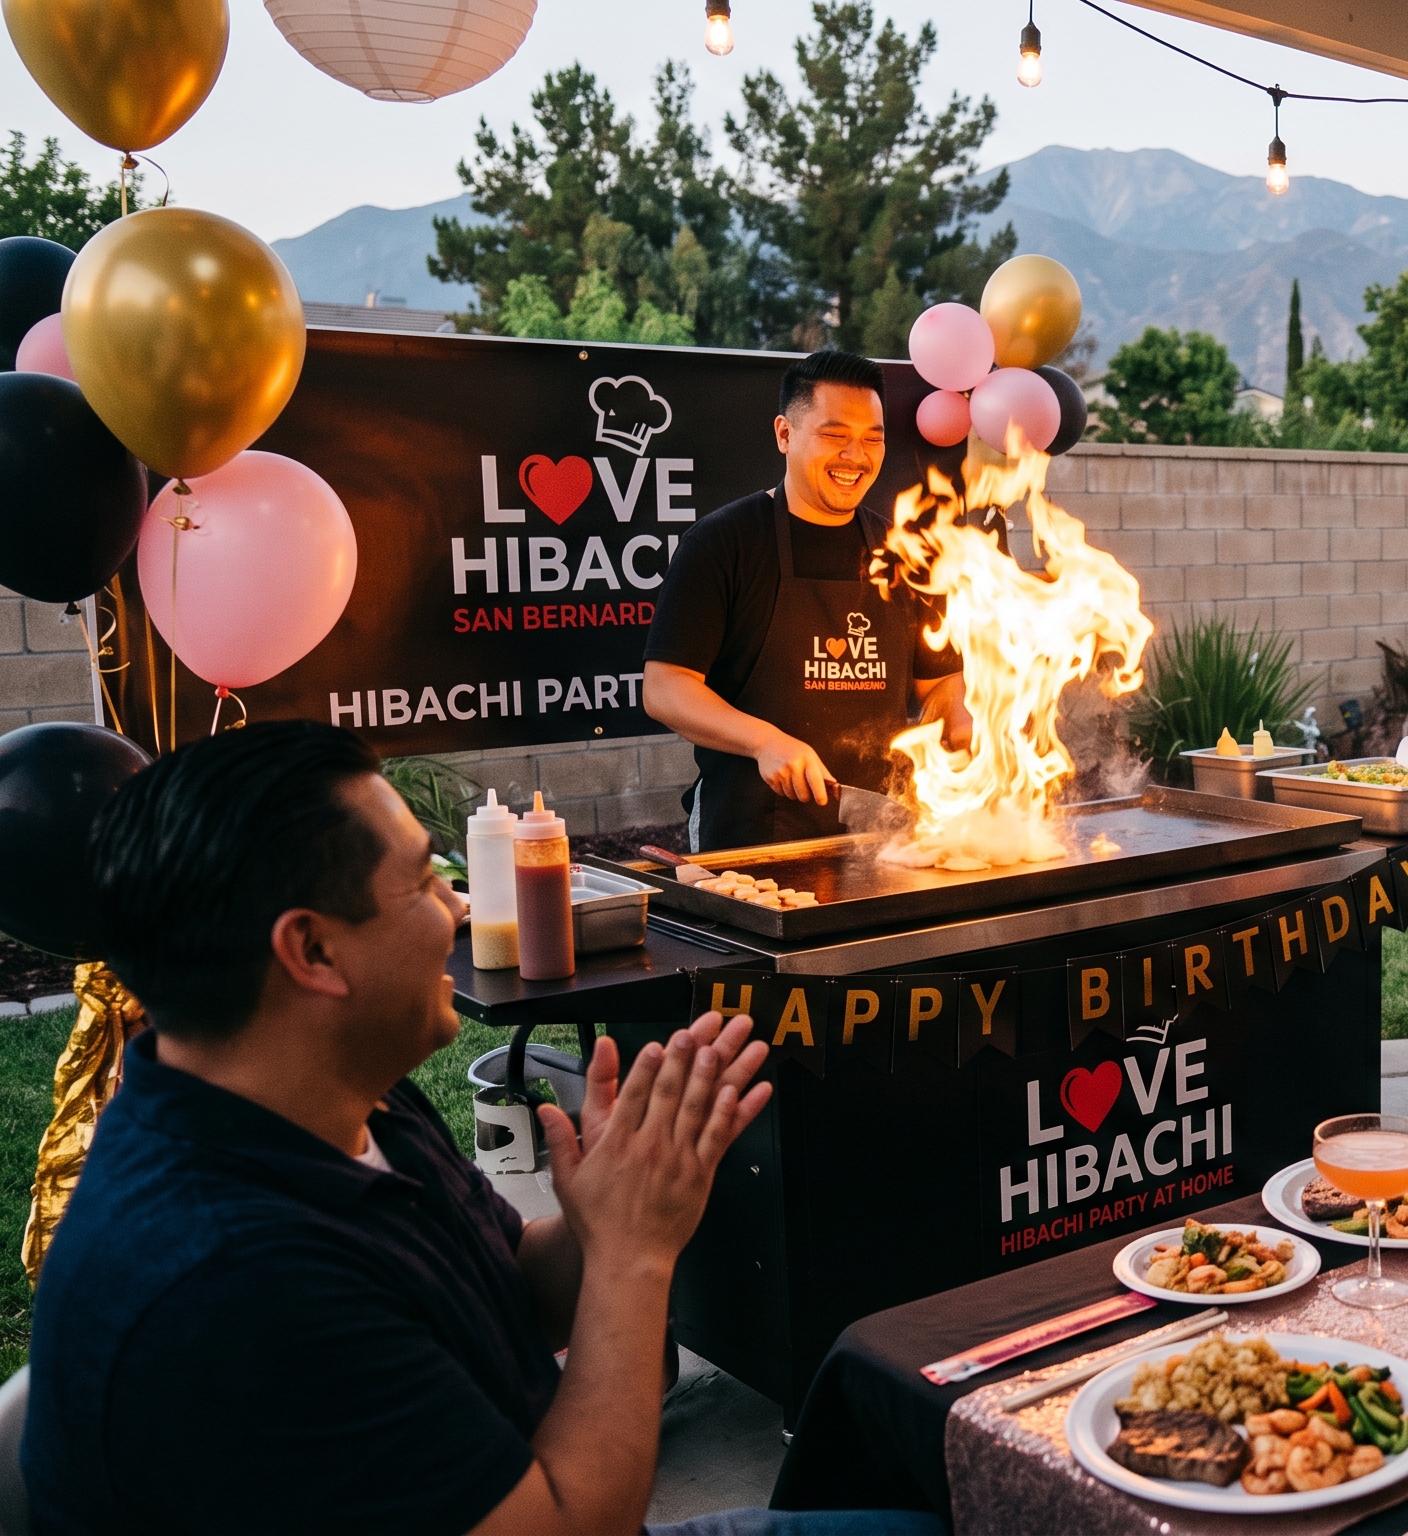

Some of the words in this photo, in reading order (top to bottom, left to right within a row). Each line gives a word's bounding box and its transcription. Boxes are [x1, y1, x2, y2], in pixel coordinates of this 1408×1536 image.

[451, 534, 679, 594] HIBAC
[453, 607, 513, 633] SAN
[523, 601, 657, 630] BERNARD
[804, 660, 887, 679] HIBACHI
[804, 680, 826, 690] SAN
[329, 680, 522, 728] HIBACHI
[537, 673, 645, 713] PART
[710, 979, 1007, 1047] HAPPY
[1000, 1103, 1233, 1223] HIBACHI
[1001, 1212, 1083, 1256] HIBACHI
[1089, 1191, 1149, 1229] PARTY
[1153, 1183, 1176, 1209] AT
[1180, 1164, 1234, 1199] HOME
